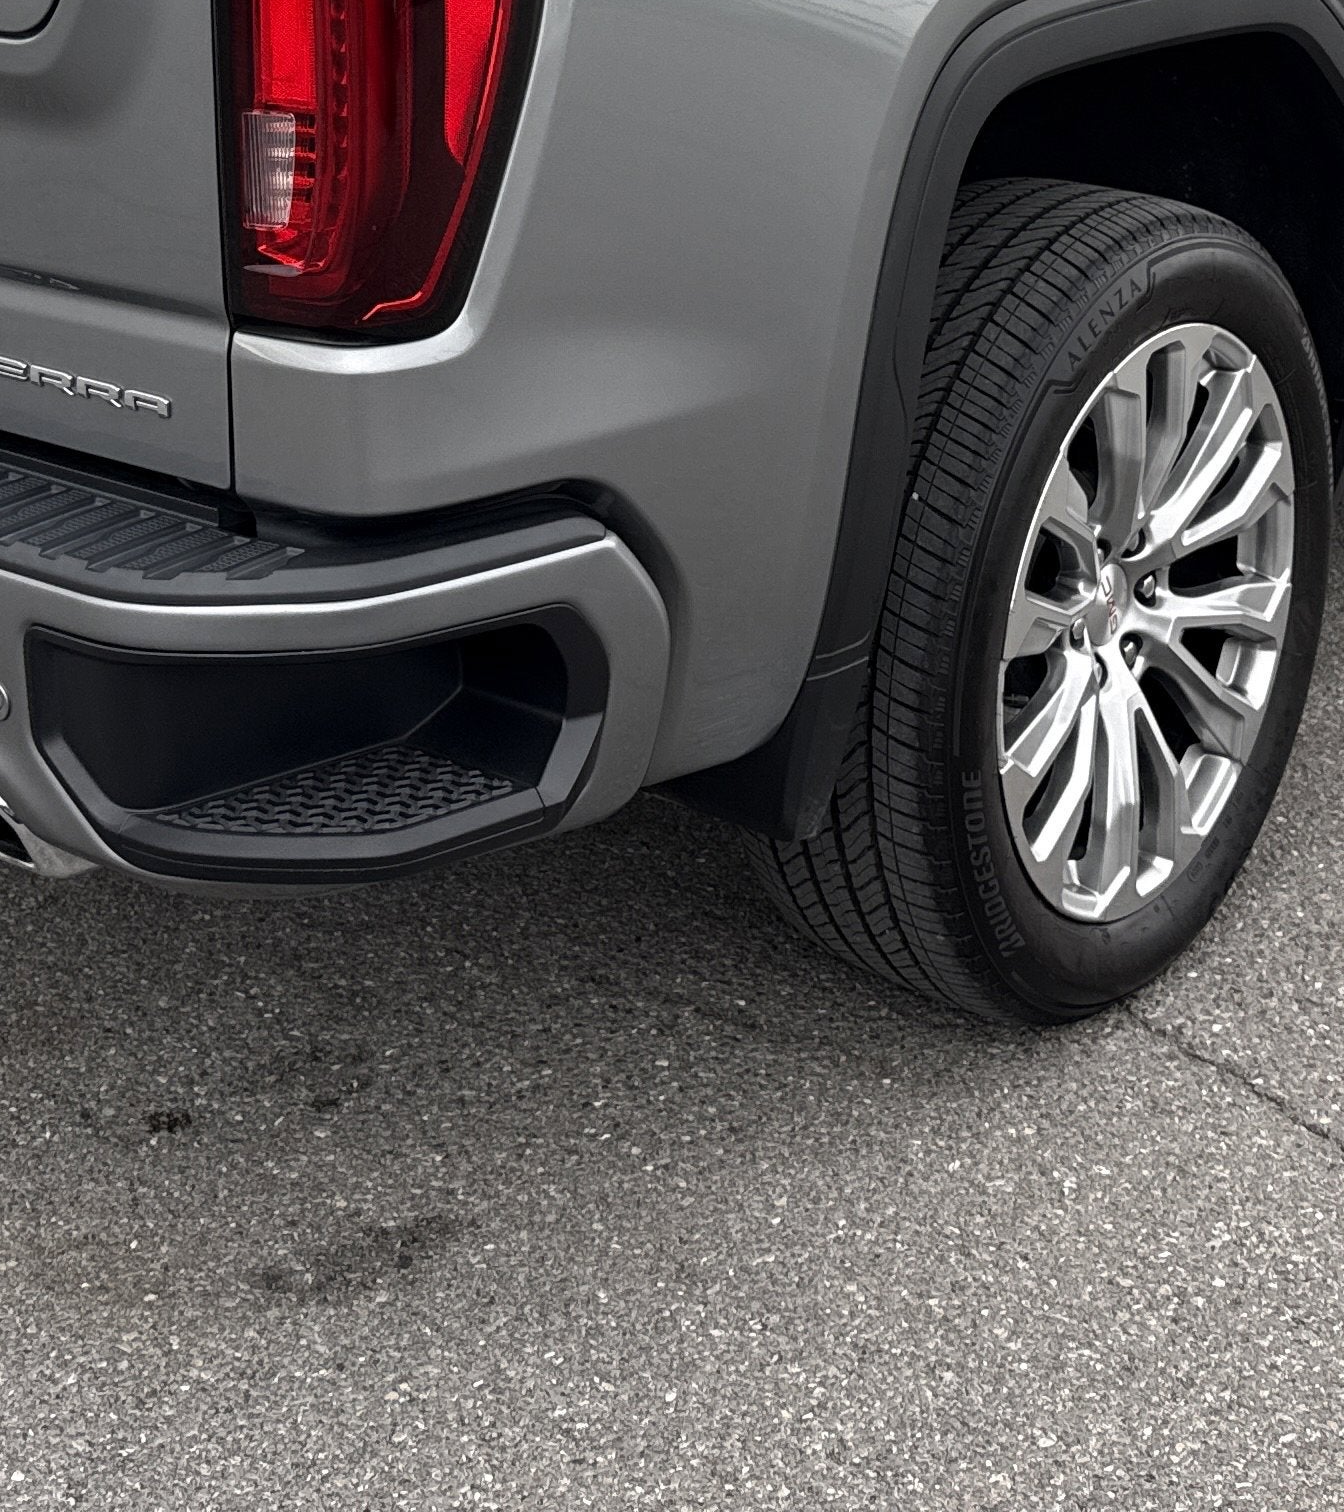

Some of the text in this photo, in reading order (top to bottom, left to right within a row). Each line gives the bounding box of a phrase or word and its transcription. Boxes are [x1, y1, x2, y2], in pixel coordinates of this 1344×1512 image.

[1066, 278, 1142, 371] ALENZA
[1100, 575, 1118, 635] GMC
[961, 768, 1027, 958] BRIDGESTONE
